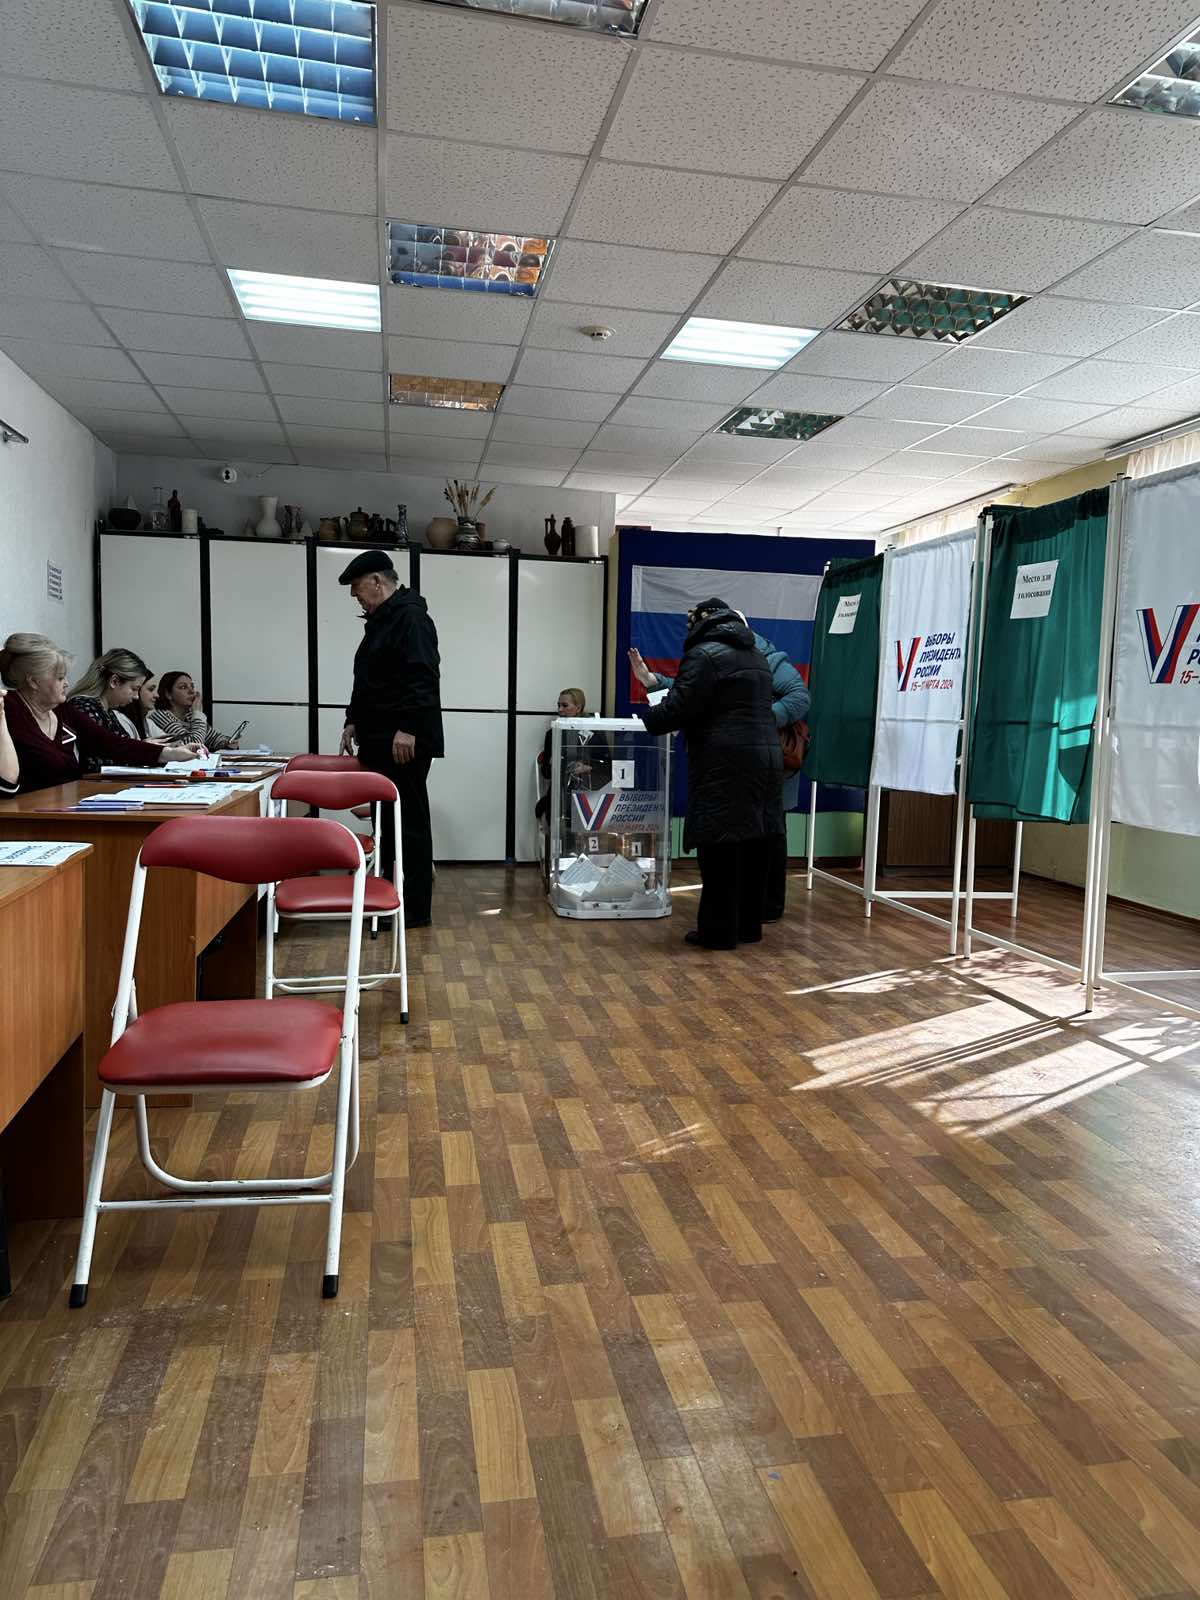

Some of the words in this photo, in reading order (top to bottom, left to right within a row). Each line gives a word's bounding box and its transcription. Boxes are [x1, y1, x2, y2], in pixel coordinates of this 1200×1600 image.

[1022, 575, 1041, 584] Место
[925, 632, 955, 647] ВЫБОРЫ
[620, 769, 626, 780] 1
[619, 793, 657, 802] ВЫБОРЫ
[610, 814, 645, 823] РОССИИ
